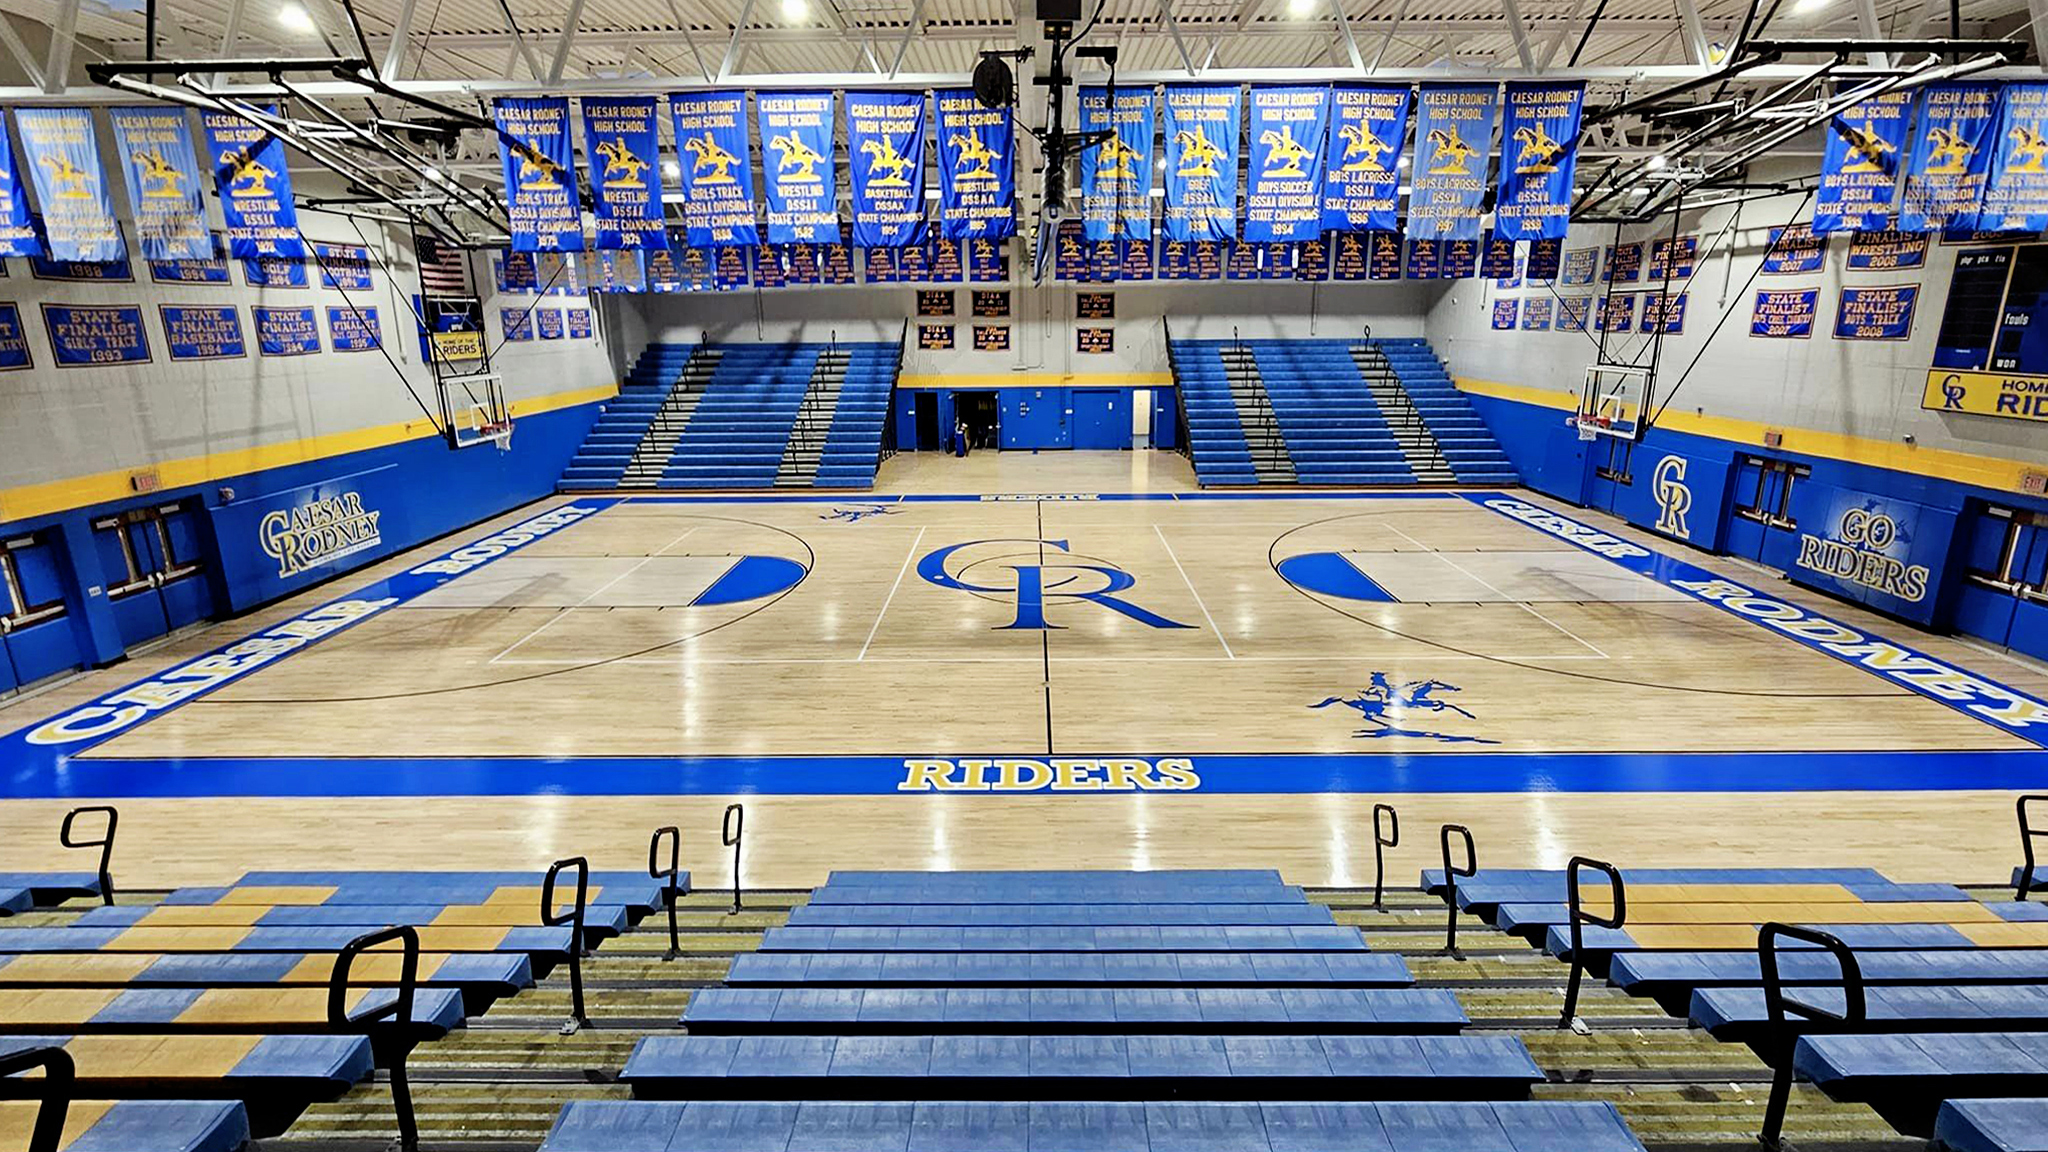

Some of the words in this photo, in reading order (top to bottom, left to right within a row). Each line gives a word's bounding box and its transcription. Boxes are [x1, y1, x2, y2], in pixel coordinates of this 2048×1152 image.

[1118, 97, 1150, 107] RODNEY
[1169, 94, 1200, 106] CAESAR
[1203, 94, 1235, 106] RODNEY
[1256, 94, 1289, 106] CAESAR
[1292, 93, 1323, 105] RODNEY
[1336, 93, 1370, 105] CAESAR
[1372, 93, 1405, 105] RODNEY
[1424, 93, 1458, 105] CAESAR
[1460, 93, 1493, 105] RODNEY
[1511, 92, 1543, 103] CAESAR
[1545, 90, 1578, 102] RODNEY
[1928, 93, 1961, 103] CAESAR
[674, 102, 705, 114] CAESAR
[708, 100, 741, 112] RODNEY
[761, 99, 793, 111] CAESAR
[796, 99, 829, 112] RODNEY
[940, 99, 972, 110] CAESAR
[498, 108, 530, 119] CAESAR
[532, 109, 565, 120] RODNEY
[586, 106, 618, 117] CAESAR
[621, 107, 652, 117] RODNEY
[852, 105, 884, 116] CAESAR
[886, 105, 920, 117] RODNEY
[1175, 111, 1194, 121] HIGH
[1197, 110, 1228, 121] SCHOOL
[1262, 109, 1281, 120] HIGH
[1284, 109, 1316, 120] SCHOOL
[1342, 108, 1361, 119] HIGH
[1363, 108, 1396, 120] SCHOOL
[1429, 108, 1449, 120] HIGH
[1451, 108, 1483, 120] SCHOOL
[1515, 106, 1535, 117] HIGH
[1536, 105, 1569, 117] SCHOOL
[1868, 108, 1900, 118] SCHOOL
[1929, 108, 1949, 118] HIGH
[1952, 108, 1991, 118] SCHOOL
[683, 116, 702, 128] HIGH
[705, 115, 736, 127] SCHOOL
[769, 114, 787, 126] HIGH
[790, 114, 823, 126] SCHOOL
[945, 115, 966, 127] HIGH
[969, 113, 1004, 125] SCHOOL
[1090, 112, 1109, 122] HIGH
[1113, 112, 1144, 122] SCHOOL
[507, 123, 526, 134] HIGH
[528, 123, 561, 135] SCHOOL
[594, 121, 613, 132] HIGH
[616, 122, 646, 132] SCHOOL
[856, 122, 878, 132] HIGH
[881, 122, 916, 133] SCHOOL
[1329, 172, 1350, 183] BOYS
[1353, 172, 1394, 182] LACROSSE
[1847, 175, 1896, 186] LACROSSE
[954, 181, 1000, 191] WRESTLING
[1258, 182, 1278, 193] BOYS
[1280, 182, 1313, 193] SOCCER
[1438, 179, 1480, 190] LACROSSE
[603, 191, 649, 202] WRESTLING
[690, 188, 717, 199] GIRLS
[719, 186, 743, 198] TRACK
[777, 185, 824, 197] WRESTLING
[865, 188, 913, 198] BASKETBALL
[516, 193, 540, 204] GIRLS
[542, 193, 568, 204] TRACK
[1279, 195, 1313, 206] DIVISION
[233, 201, 280, 211] WRESTLING
[712, 200, 747, 212] DIVISION
[1325, 200, 1349, 210] STATE
[1351, 199, 1393, 210] CHAMPIONS
[1499, 206, 1520, 216] STATE
[1523, 204, 1569, 215] CHAMPIONS
[1817, 204, 1841, 215] STATE
[858, 213, 880, 222] STATE
[882, 212, 923, 222] CHAMPIONS
[945, 208, 967, 218] STATE
[969, 207, 1011, 217] CHAMPIONS
[1250, 210, 1272, 221] STATE
[1275, 209, 1319, 220] CHAMPIONS
[1410, 207, 1435, 218] STATE
[1438, 207, 1480, 218] CHAMPIONS
[686, 216, 709, 227] STATE
[712, 214, 755, 226] CHAMPIONS
[768, 212, 794, 225] STATE
[797, 213, 838, 224] CHAMPIONS
[511, 221, 535, 231] STATE
[538, 221, 580, 232] CHAMPIONS
[595, 219, 619, 230] STATE
[622, 219, 664, 231] CHAMPIONS
[228, 229, 251, 239] STATE
[252, 229, 298, 239] CHAMPIONS
[1851, 242, 1923, 255] WRESTLING
[1779, 261, 1803, 271] 2007
[1869, 257, 1896, 266] 2008
[1768, 294, 1803, 304] STATE
[1857, 292, 1898, 301] STATE
[1759, 305, 1809, 314] FINALIST
[1845, 302, 1907, 313] FINALIST
[70, 312, 121, 322] STATE
[181, 311, 221, 320] STATE
[270, 312, 301, 320] STATE
[1873, 314, 1900, 324] TRACK
[2005, 314, 2029, 325] fouls
[57, 324, 136, 336] FINALIST
[171, 322, 234, 332] FINALIST
[262, 322, 312, 331] FINALIST
[1767, 326, 1790, 335] 2007
[1856, 327, 1883, 336] 2008
[65, 338, 96, 348] GIRLS
[106, 338, 138, 347] TRACK
[171, 333, 240, 344] BASEBALL
[91, 350, 123, 361] 1993
[443, 345, 476, 355] RIDERS
[1997, 360, 2015, 368] won
[1652, 455, 1692, 539] CR
[260, 492, 365, 558] CAESAR
[1483, 499, 1651, 560] CAESAR
[1840, 508, 1896, 549] GO
[277, 511, 379, 579] RODNEY
[409, 504, 598, 576] RODNEY
[1796, 534, 1930, 603] RIDERS
[917, 539, 1201, 629] CR
[1668, 579, 2047, 726] RODNEY
[24, 596, 400, 746] CAESAR
[897, 758, 1201, 791] RIDERS
